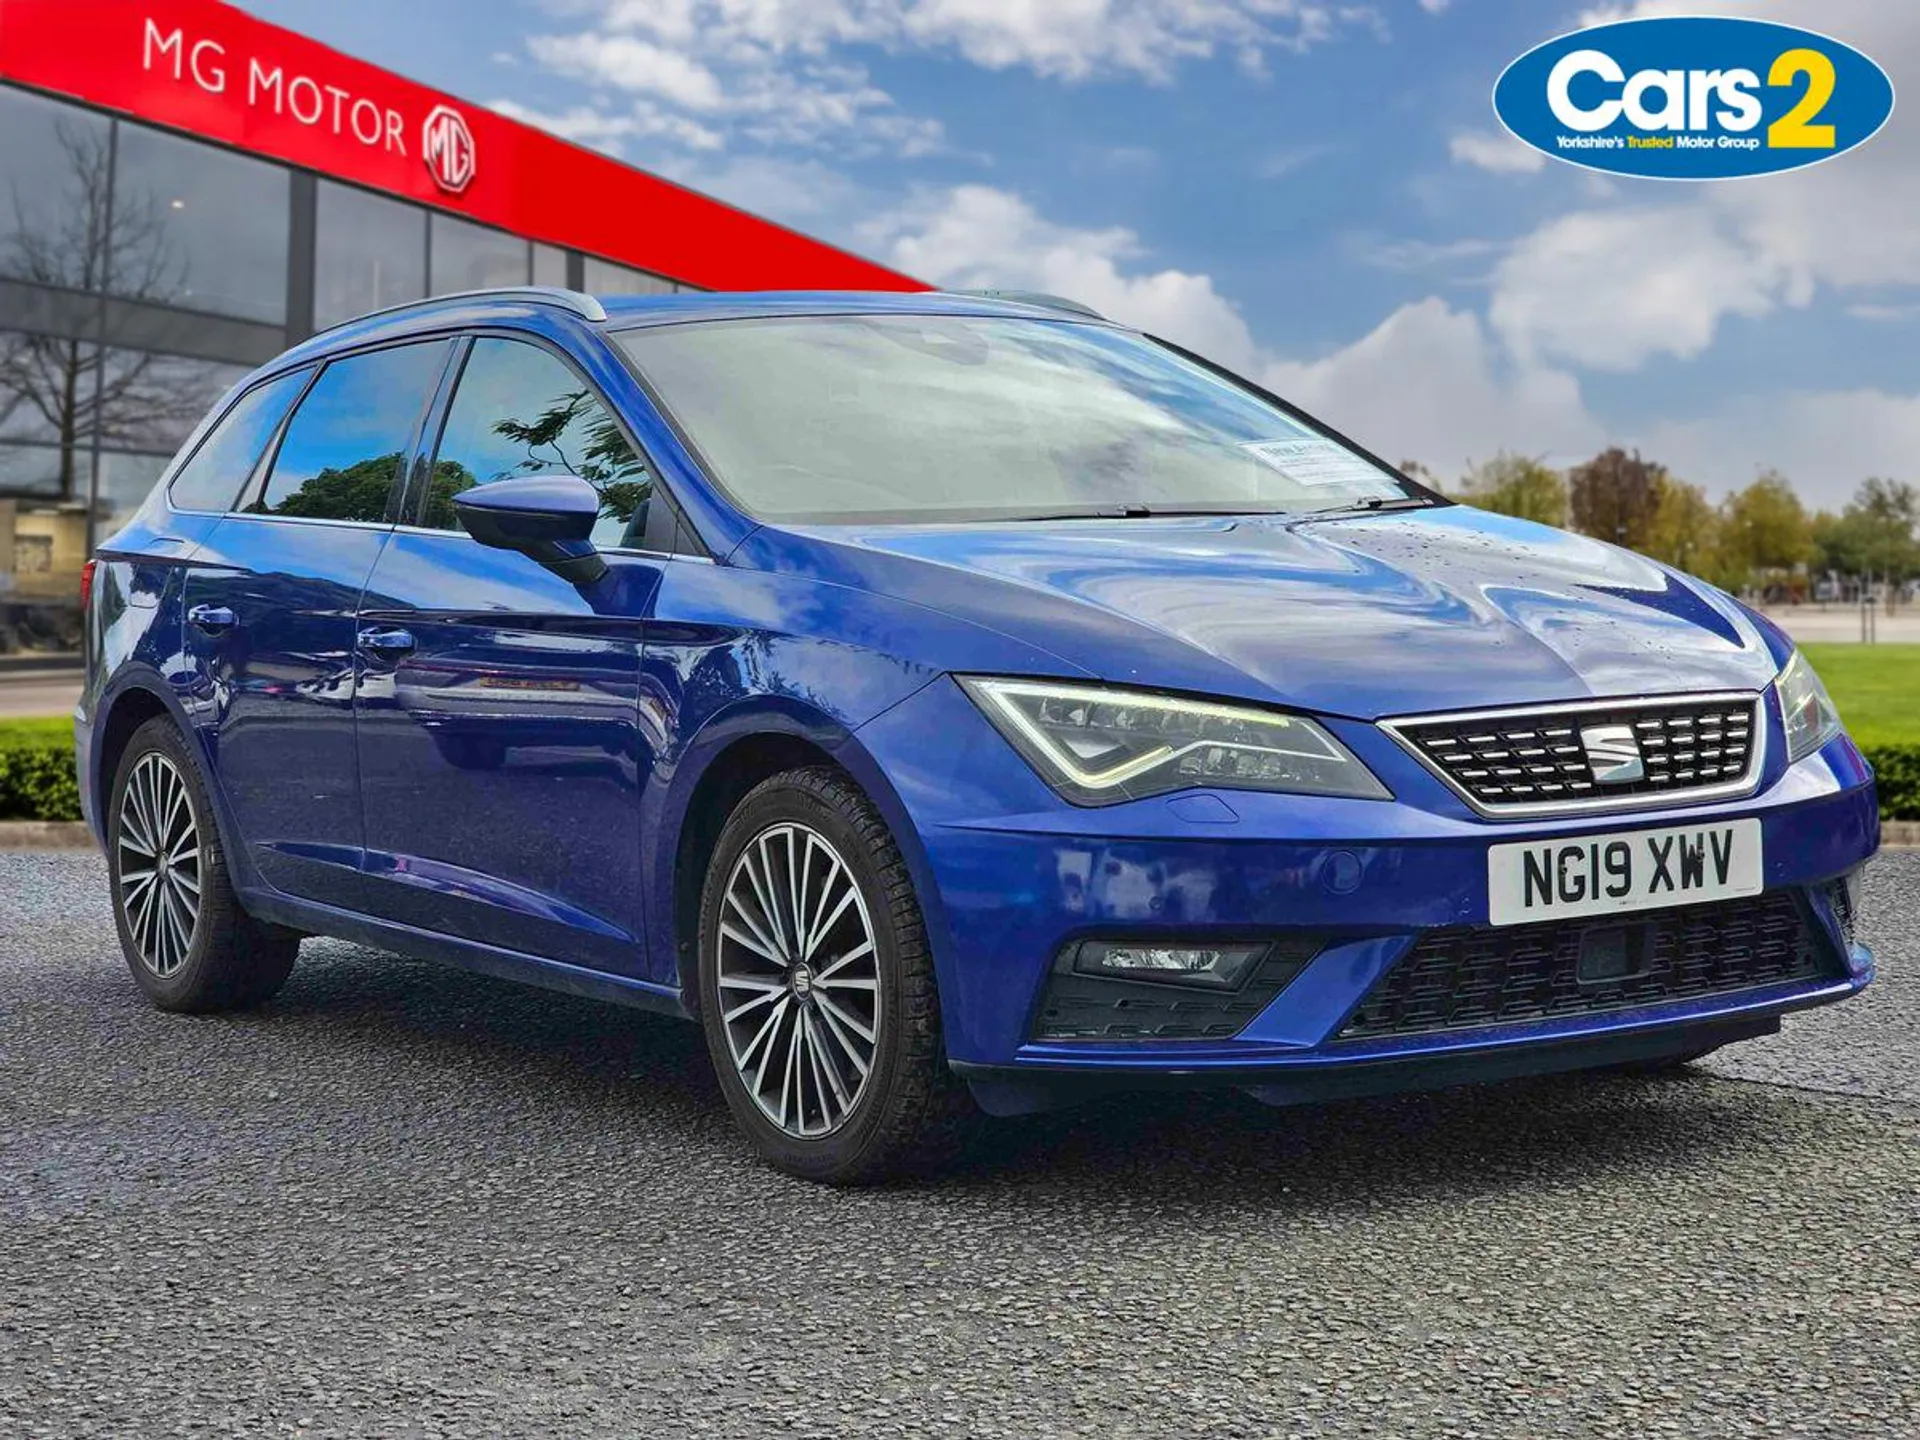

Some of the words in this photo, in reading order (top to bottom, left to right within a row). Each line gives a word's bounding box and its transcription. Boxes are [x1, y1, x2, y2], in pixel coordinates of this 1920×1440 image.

[143, 17, 226, 93] MG
[247, 57, 406, 157] MOTOR
[429, 114, 470, 185] MG
[1647, 828, 1734, 894] XWV
